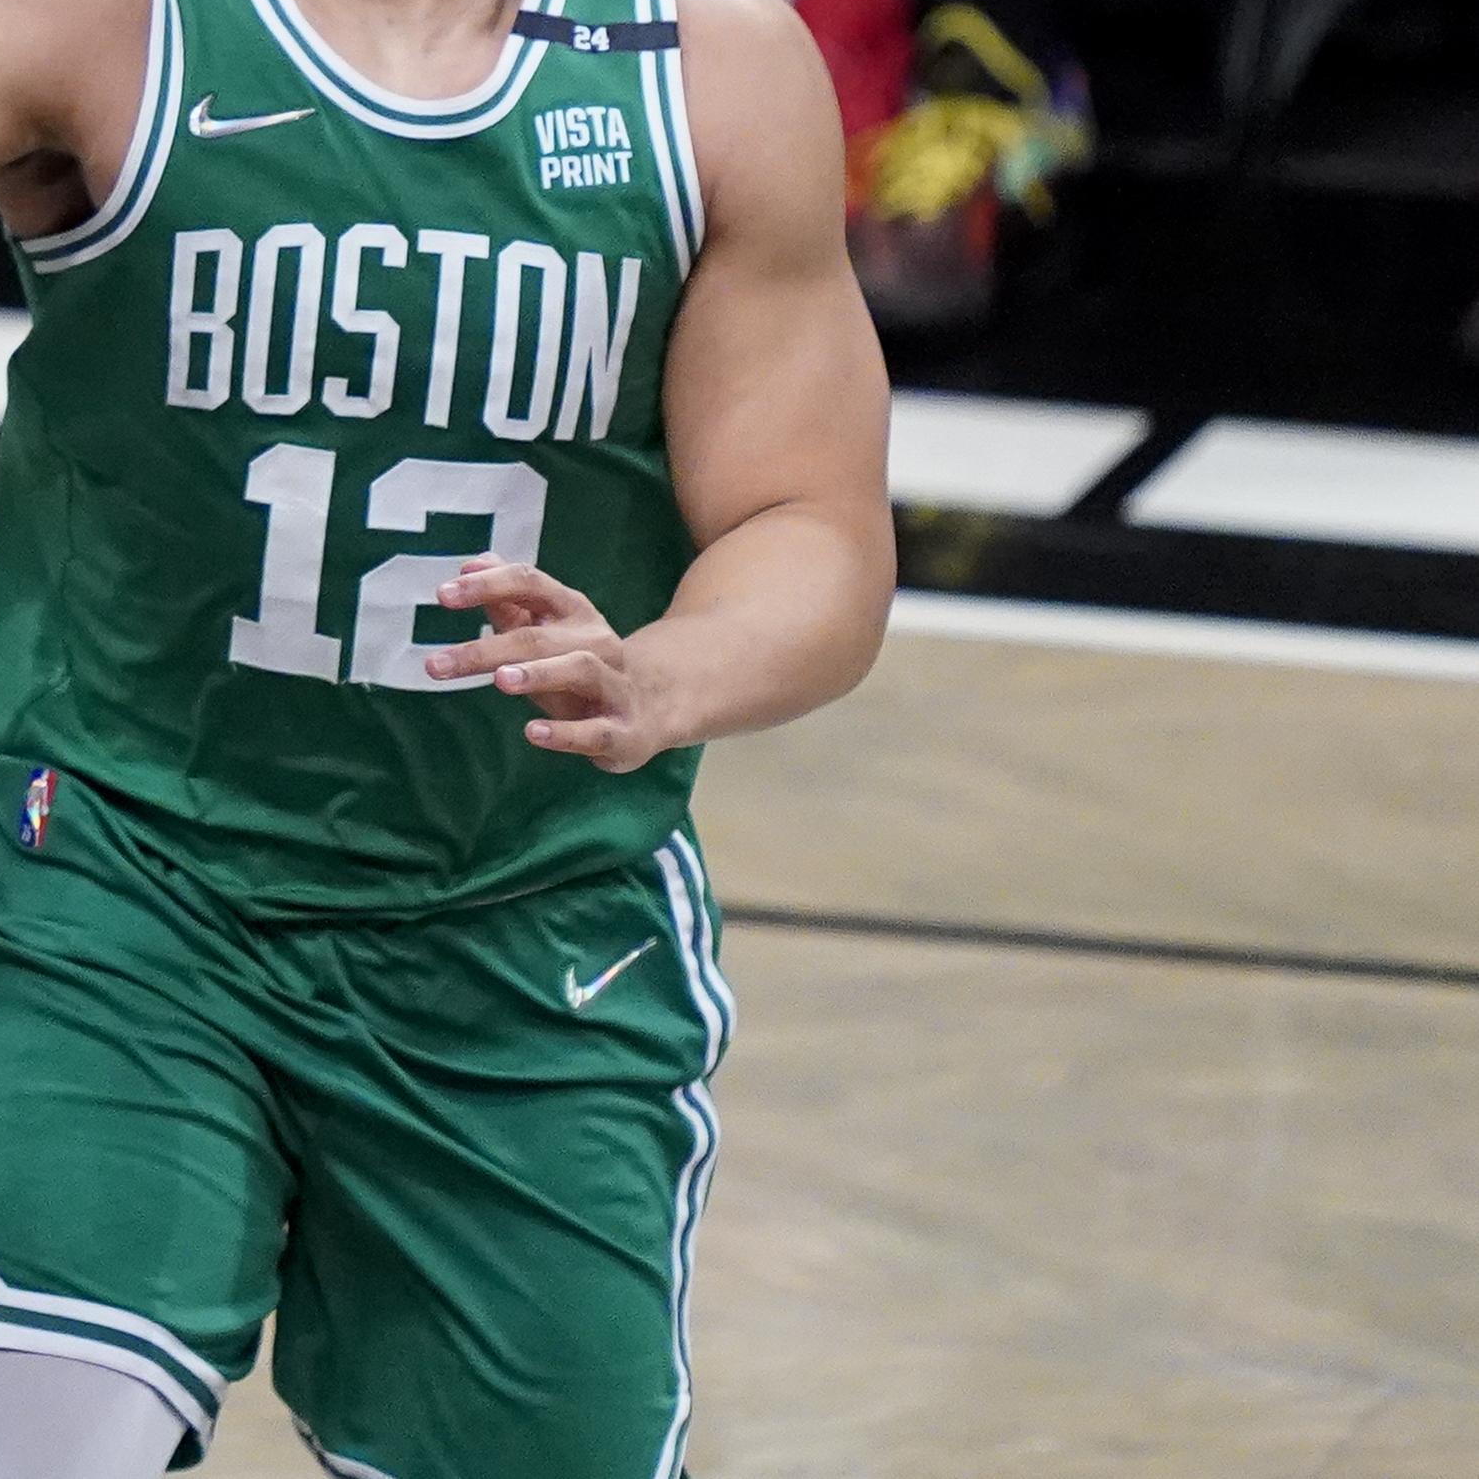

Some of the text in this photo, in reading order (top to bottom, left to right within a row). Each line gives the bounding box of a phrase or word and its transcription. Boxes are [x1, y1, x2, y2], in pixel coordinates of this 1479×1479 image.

[572, 24, 611, 52] 24
[534, 105, 632, 155] VISTA
[540, 150, 633, 190] PRINT
[166, 223, 642, 441] BOSTON
[228, 443, 548, 691] 12
